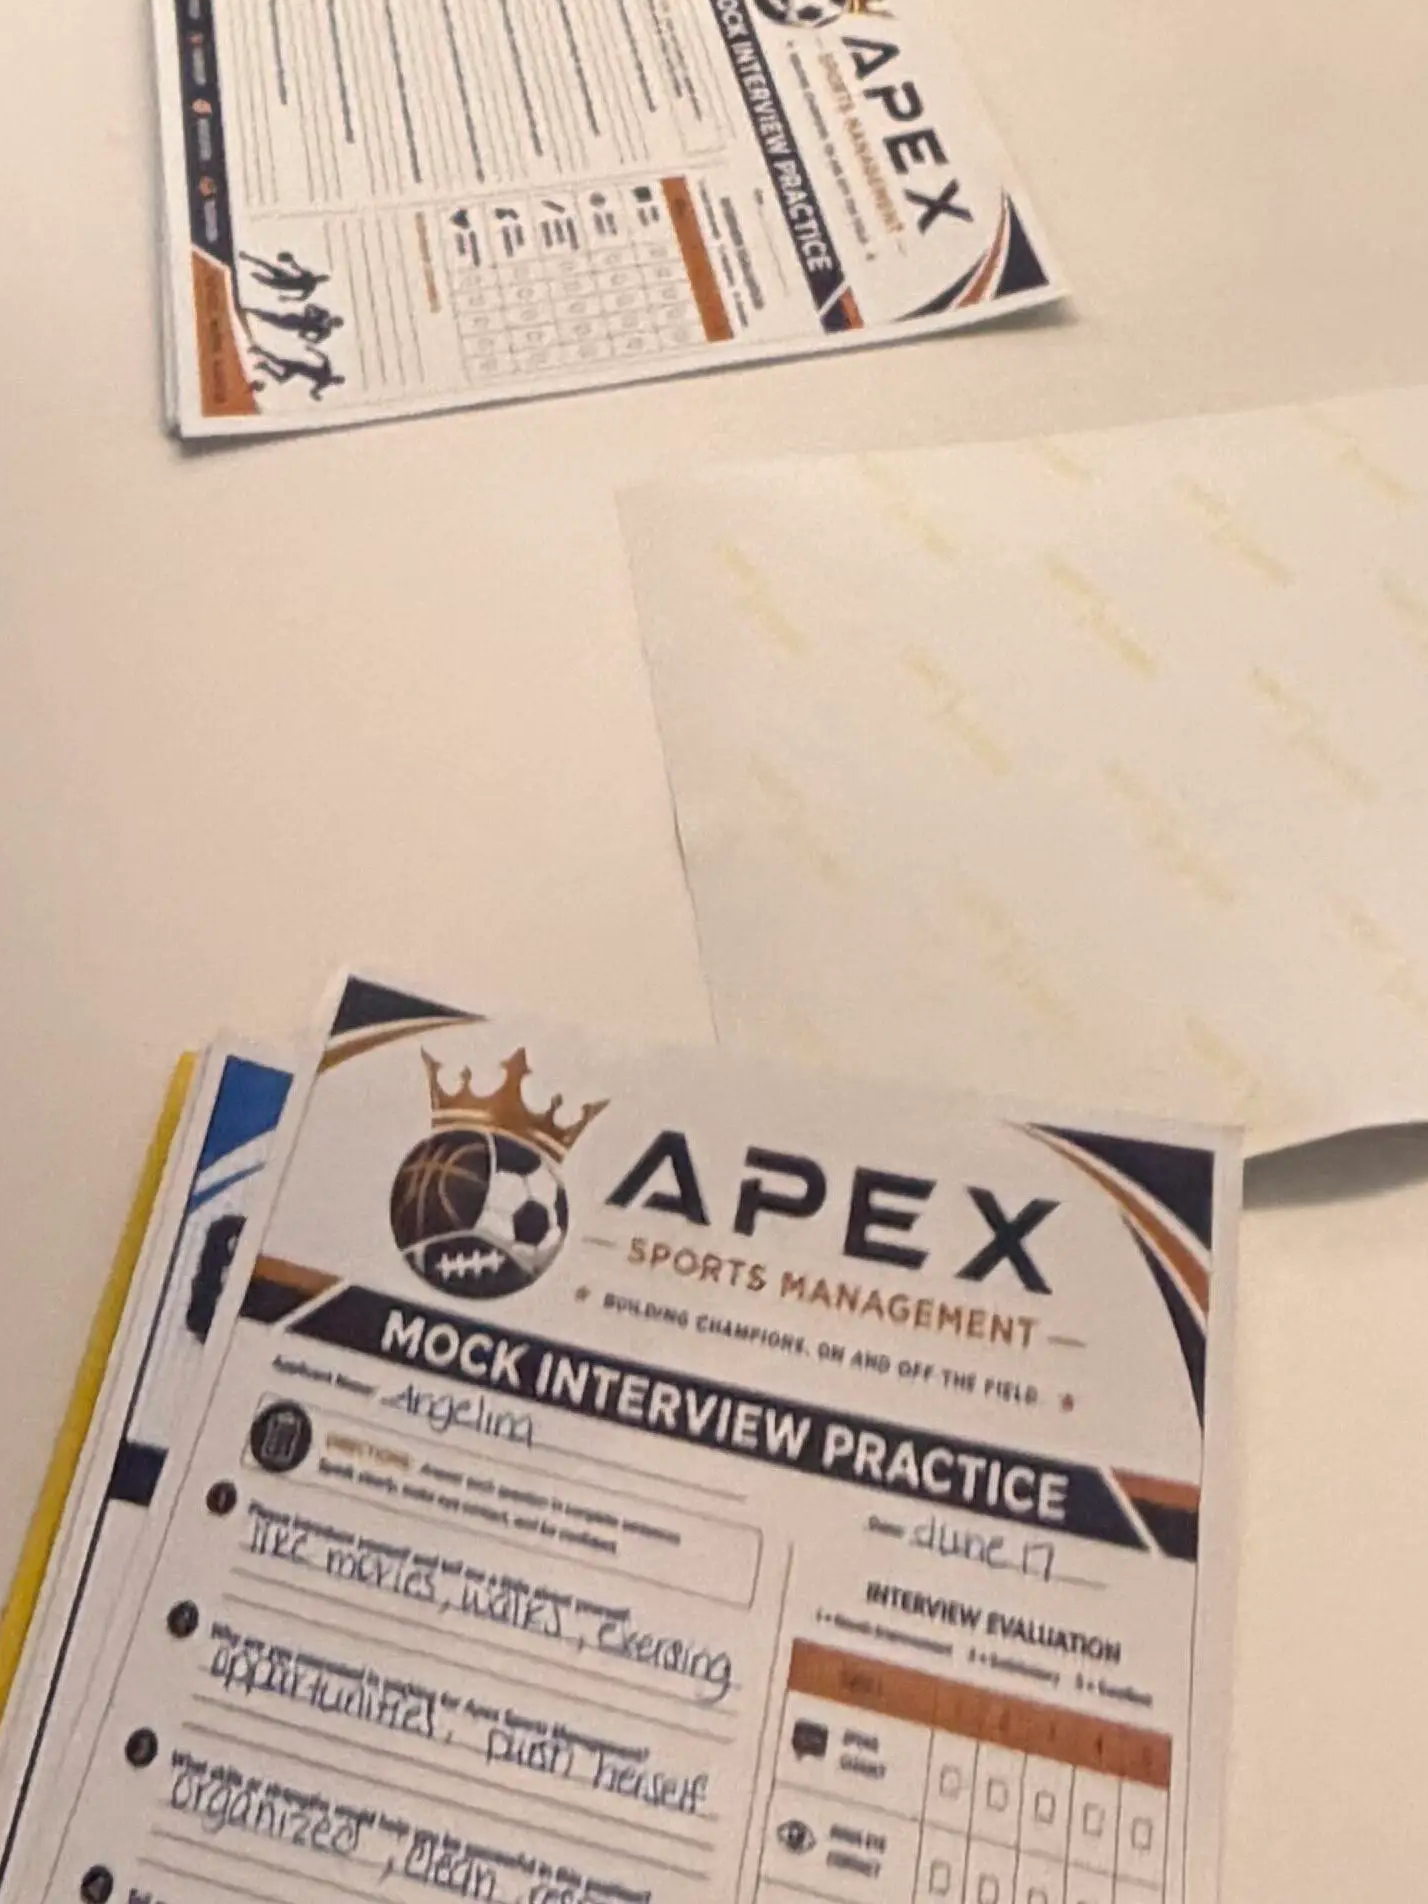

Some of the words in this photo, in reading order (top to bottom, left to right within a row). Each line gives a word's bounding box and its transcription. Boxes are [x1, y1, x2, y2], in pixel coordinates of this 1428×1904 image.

[730, 40, 790, 154] INTERVIEW
[772, 158, 833, 272] PRACTICE
[841, 36, 974, 235] APEX
[604, 1130, 1063, 1295] APEX
[603, 1293, 688, 1330] BUILDING
[850, 1348, 891, 1375] AND
[897, 1357, 936, 1384] OFF
[942, 1366, 977, 1393] THE
[626, 1237, 767, 1292] SPORTS
[779, 1270, 1040, 1348] MANAGEMENT
[380, 1309, 526, 1388] MOCK
[535, 1352, 811, 1461] INTERVIEW
[821, 1422, 1070, 1523] PRACTICE
[909, 1514, 1006, 1570] June
[866, 1581, 982, 1632] INTERVIEW
[985, 1612, 1122, 1665] EVALUATION
